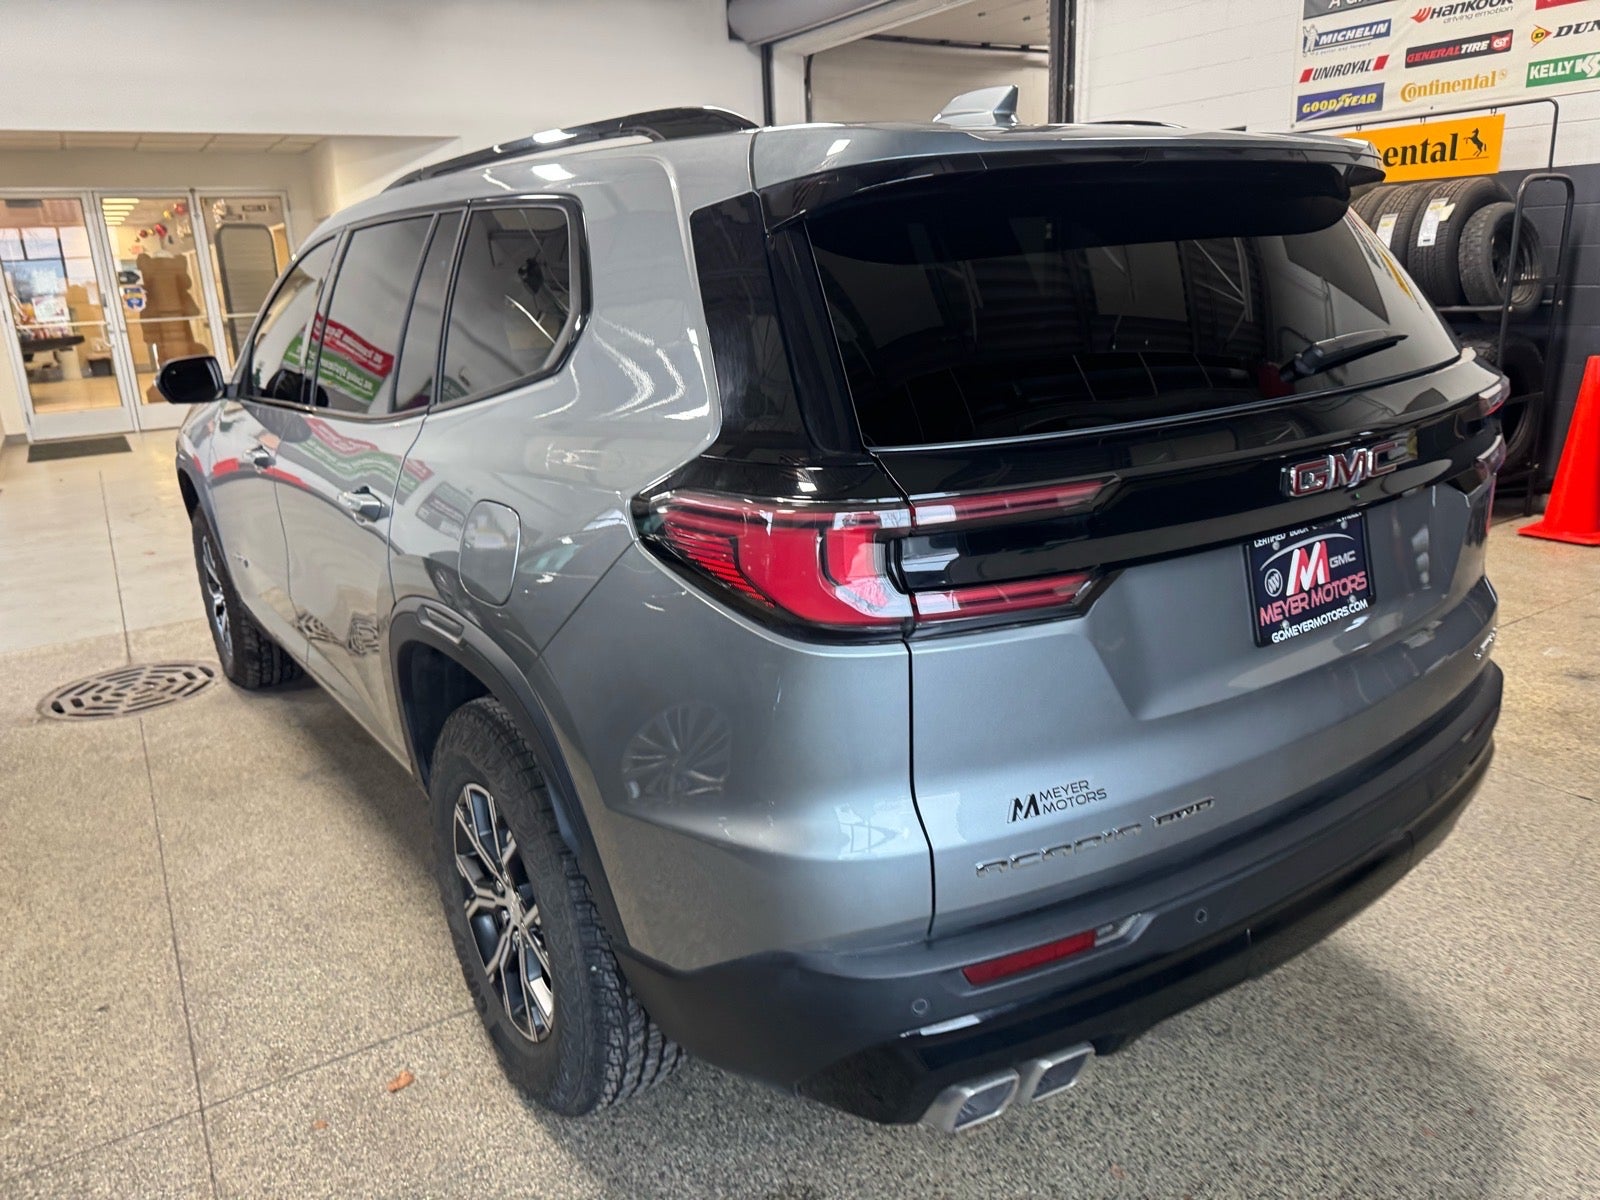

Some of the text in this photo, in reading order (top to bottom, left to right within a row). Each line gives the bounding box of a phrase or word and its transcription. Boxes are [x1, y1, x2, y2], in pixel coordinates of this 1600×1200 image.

[1443, 6, 1513, 24] driving emotion
[1319, 22, 1389, 45] MICHELIN
[1406, 45, 1460, 63] GENERAL
[1460, 40, 1489, 54] TIRE
[1312, 59, 1372, 81] UNIROYAL
[1529, 60, 1574, 80] KELLY
[1400, 70, 1497, 103] Continental
[1302, 92, 1377, 113] GOODYEAR
[1377, 133, 1459, 168] ental
[1289, 441, 1398, 497] GMC
[1329, 550, 1357, 568] GMC
[1260, 571, 1367, 627] MEYER MOTORS
[1271, 598, 1369, 643] GOMEYERMOTORS.COM
[1039, 779, 1090, 801] MEYER
[1042, 788, 1107, 815] MOTORS
